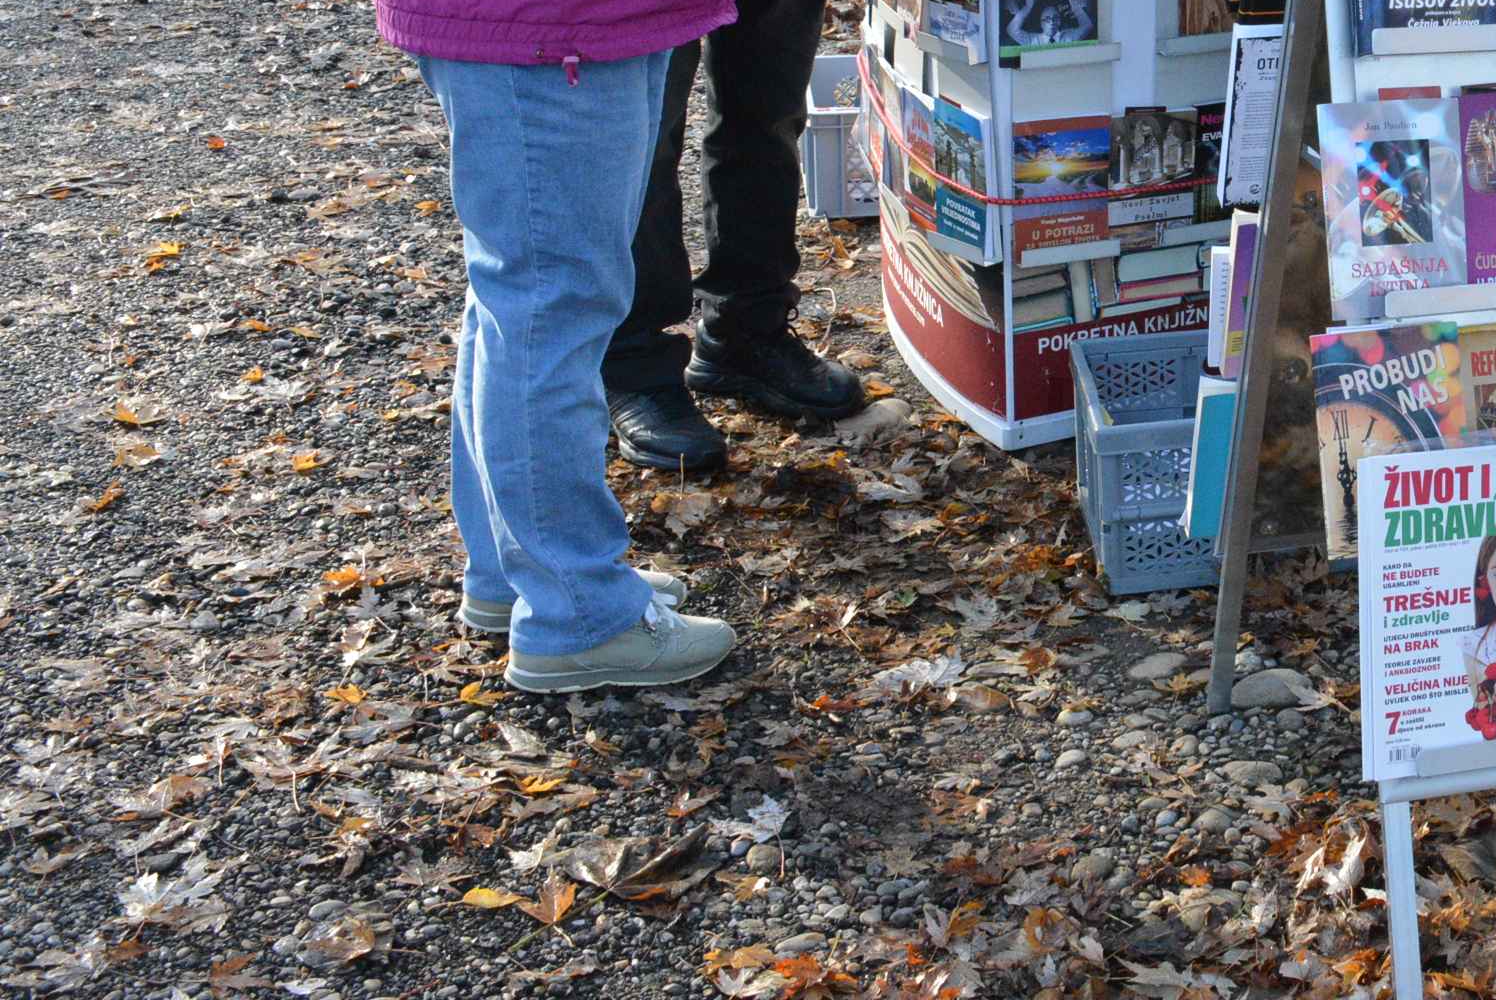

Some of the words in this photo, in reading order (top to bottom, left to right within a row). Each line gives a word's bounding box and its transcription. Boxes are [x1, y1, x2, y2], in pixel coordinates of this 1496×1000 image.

[1032, 231, 1040, 240] U
[1045, 223, 1095, 239] POTRAZI
[1351, 254, 1449, 278] SADAŠNJA
[1144, 303, 1208, 334] KNJIŽN
[1339, 346, 1447, 400] PROBUDI
[1397, 376, 1449, 414] NAS
[1384, 464, 1473, 509] ŽIVOT
[1481, 463, 1490, 499] I
[1383, 571, 1397, 581] NE
[1400, 567, 1440, 580] BUDETE
[1383, 586, 1472, 613] TREŠNJE
[1384, 616, 1388, 628] i
[1392, 610, 1450, 628] zdravlje
[1384, 642, 1400, 655] NA
[1405, 639, 1439, 652] BRAK
[1385, 679, 1440, 695] VELIČINA
[1385, 711, 1402, 735] 7
